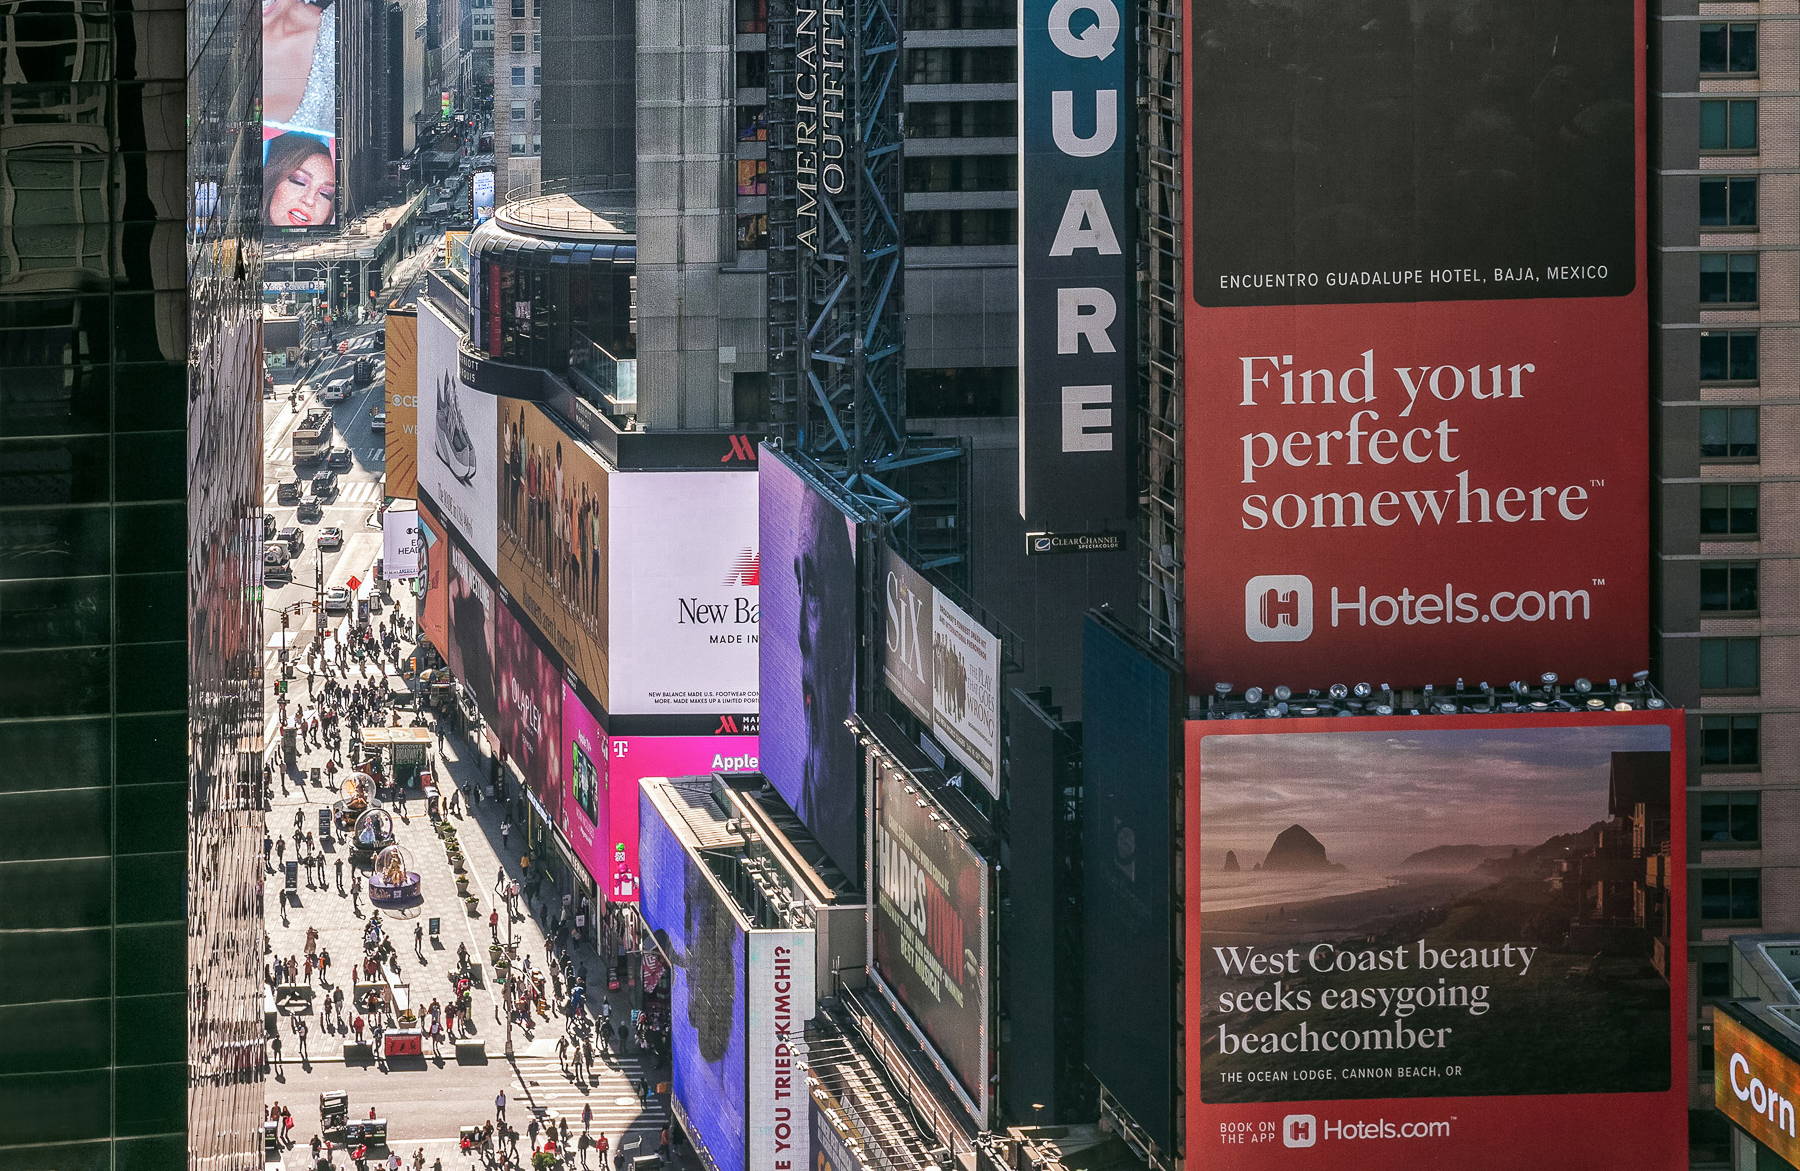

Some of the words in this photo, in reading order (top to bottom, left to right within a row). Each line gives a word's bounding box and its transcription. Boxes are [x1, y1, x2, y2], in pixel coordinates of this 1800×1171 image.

[796, 8, 818, 255] AMERICAN
[1219, 272, 1319, 290] ENCUENTRO
[1326, 270, 1423, 287] GUADALUPE
[1430, 269, 1487, 285] HOTEL,
[1494, 267, 1541, 283] BAJA,
[1547, 265, 1609, 281] MEXICO
[1238, 348, 1378, 406] Find
[1393, 362, 1537, 418] your
[1239, 409, 1462, 484] perfect
[678, 597, 729, 625] New
[885, 570, 926, 684] SIX
[709, 635, 742, 644] MADE
[747, 635, 759, 644] IN
[978, 667, 993, 693] PLAY
[711, 753, 759, 772] Apple
[900, 934, 915, 968] BEST
[915, 952, 941, 1004] MUSICAL
[1212, 945, 1300, 976] West
[1308, 943, 1409, 973] Coast
[1417, 938, 1538, 976] beauty
[774, 945, 791, 1036] KIMCHI?
[1218, 980, 1312, 1013] seeks
[1320, 977, 1491, 1018] easygoing
[1218, 1018, 1453, 1055] beachcomber
[775, 1043, 791, 1101] TRIED
[1220, 1072, 1243, 1083] THE
[1247, 1070, 1289, 1083] OCEAN
[1341, 1067, 1393, 1080] CANNON
[1445, 1065, 1463, 1077] OR
[1729, 1052, 1796, 1139] Corn
[775, 1107, 792, 1155] YOU
[1220, 1122, 1253, 1133] BOOK
[1258, 1121, 1276, 1132] ON
[1220, 1133, 1245, 1144] THE
[1251, 1133, 1275, 1144] APP
